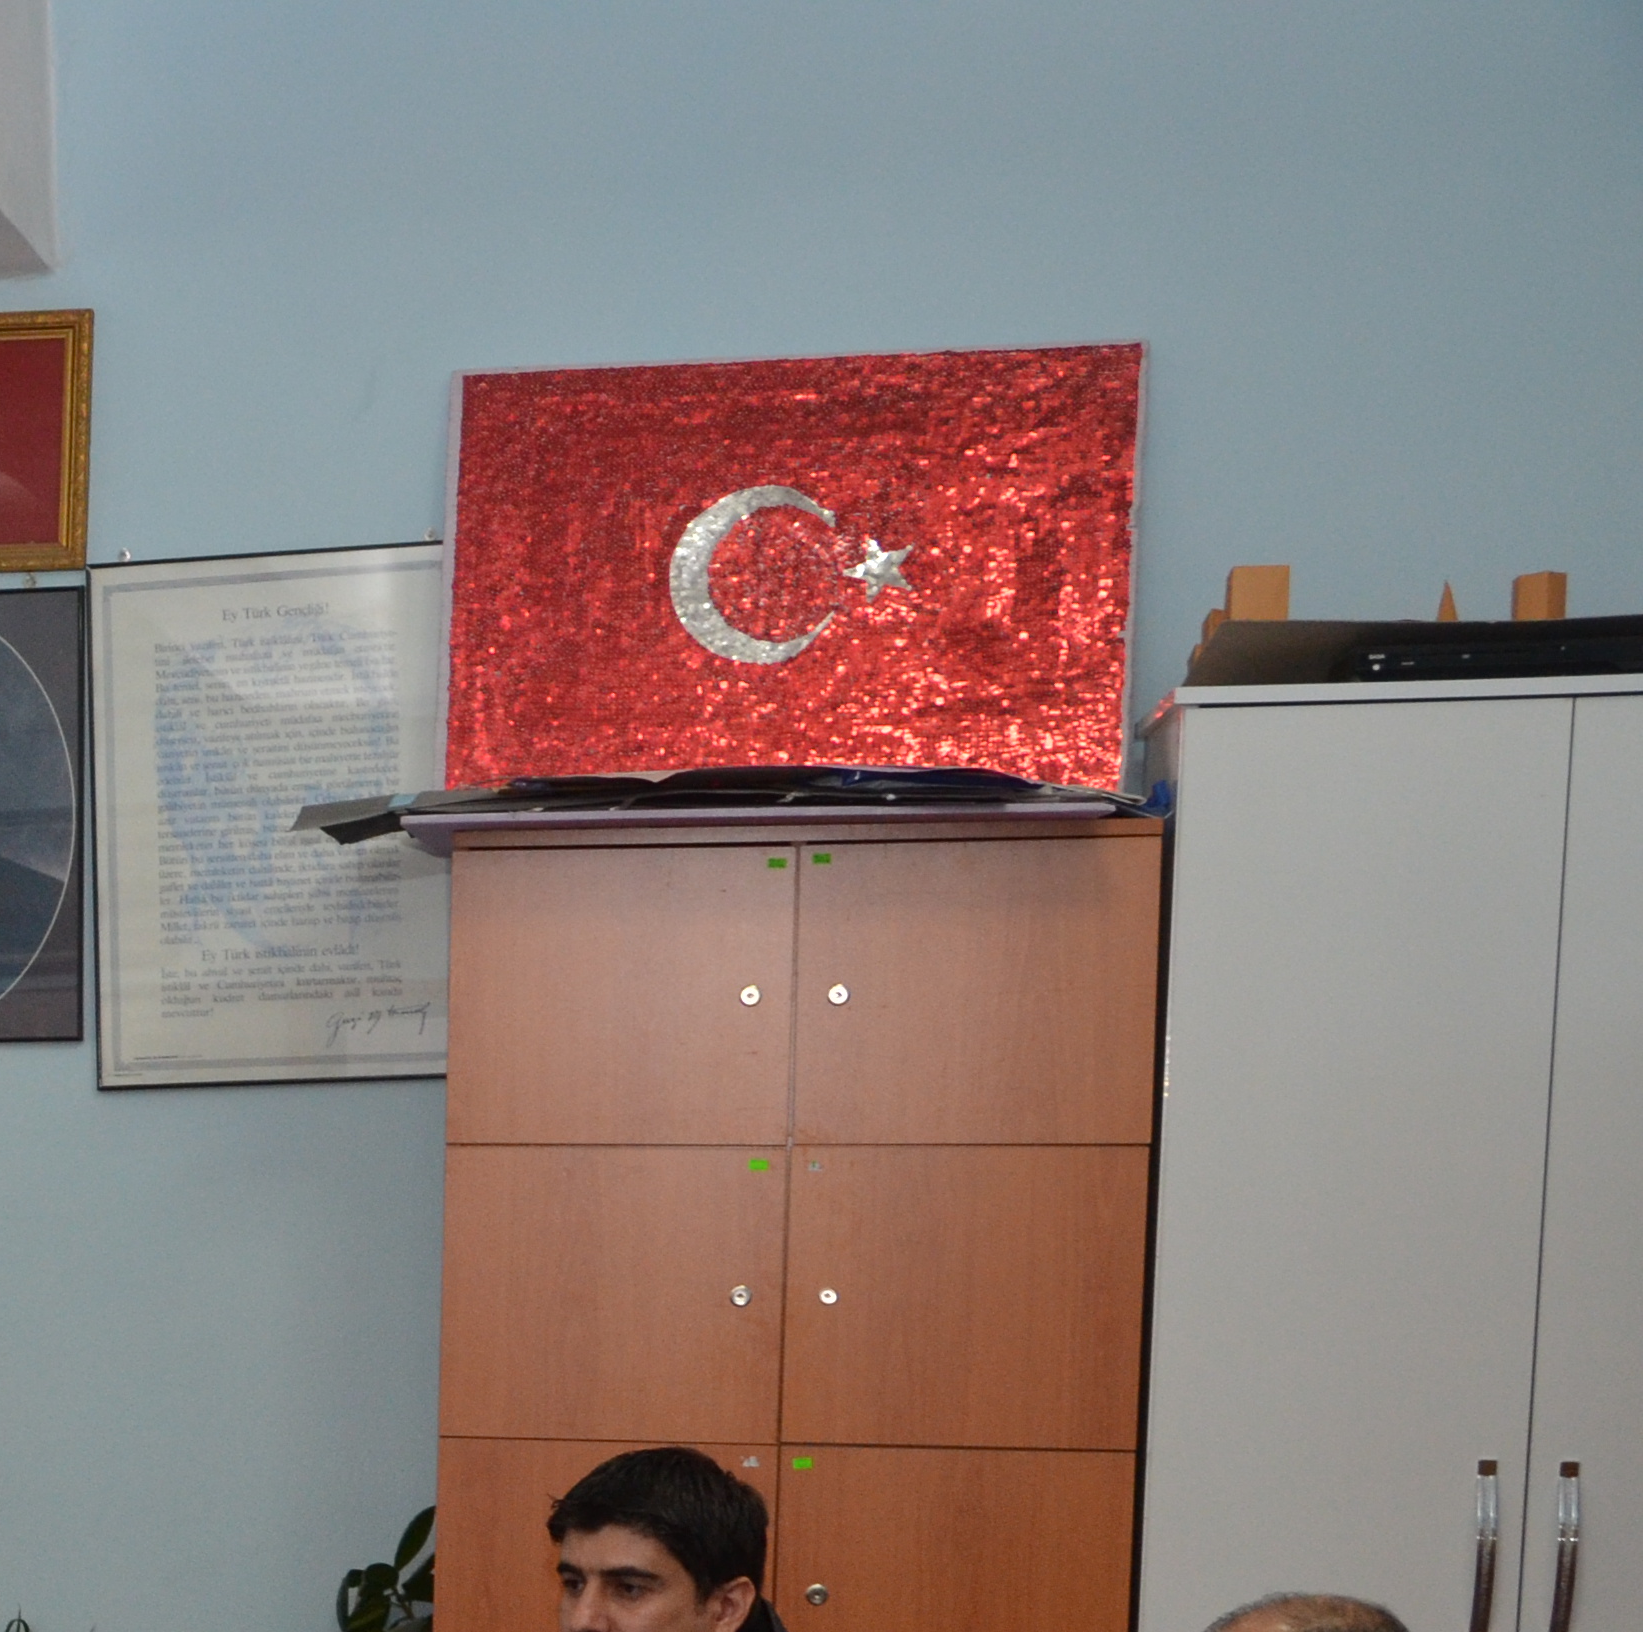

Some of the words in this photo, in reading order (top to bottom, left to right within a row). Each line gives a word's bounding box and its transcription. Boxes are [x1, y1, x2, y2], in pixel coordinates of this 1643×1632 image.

[222, 608, 238, 623] Ey
[242, 605, 272, 620] Türk
[276, 602, 330, 618] Gençliği!
[202, 949, 217, 962] Ey
[221, 947, 250, 961] Türk
